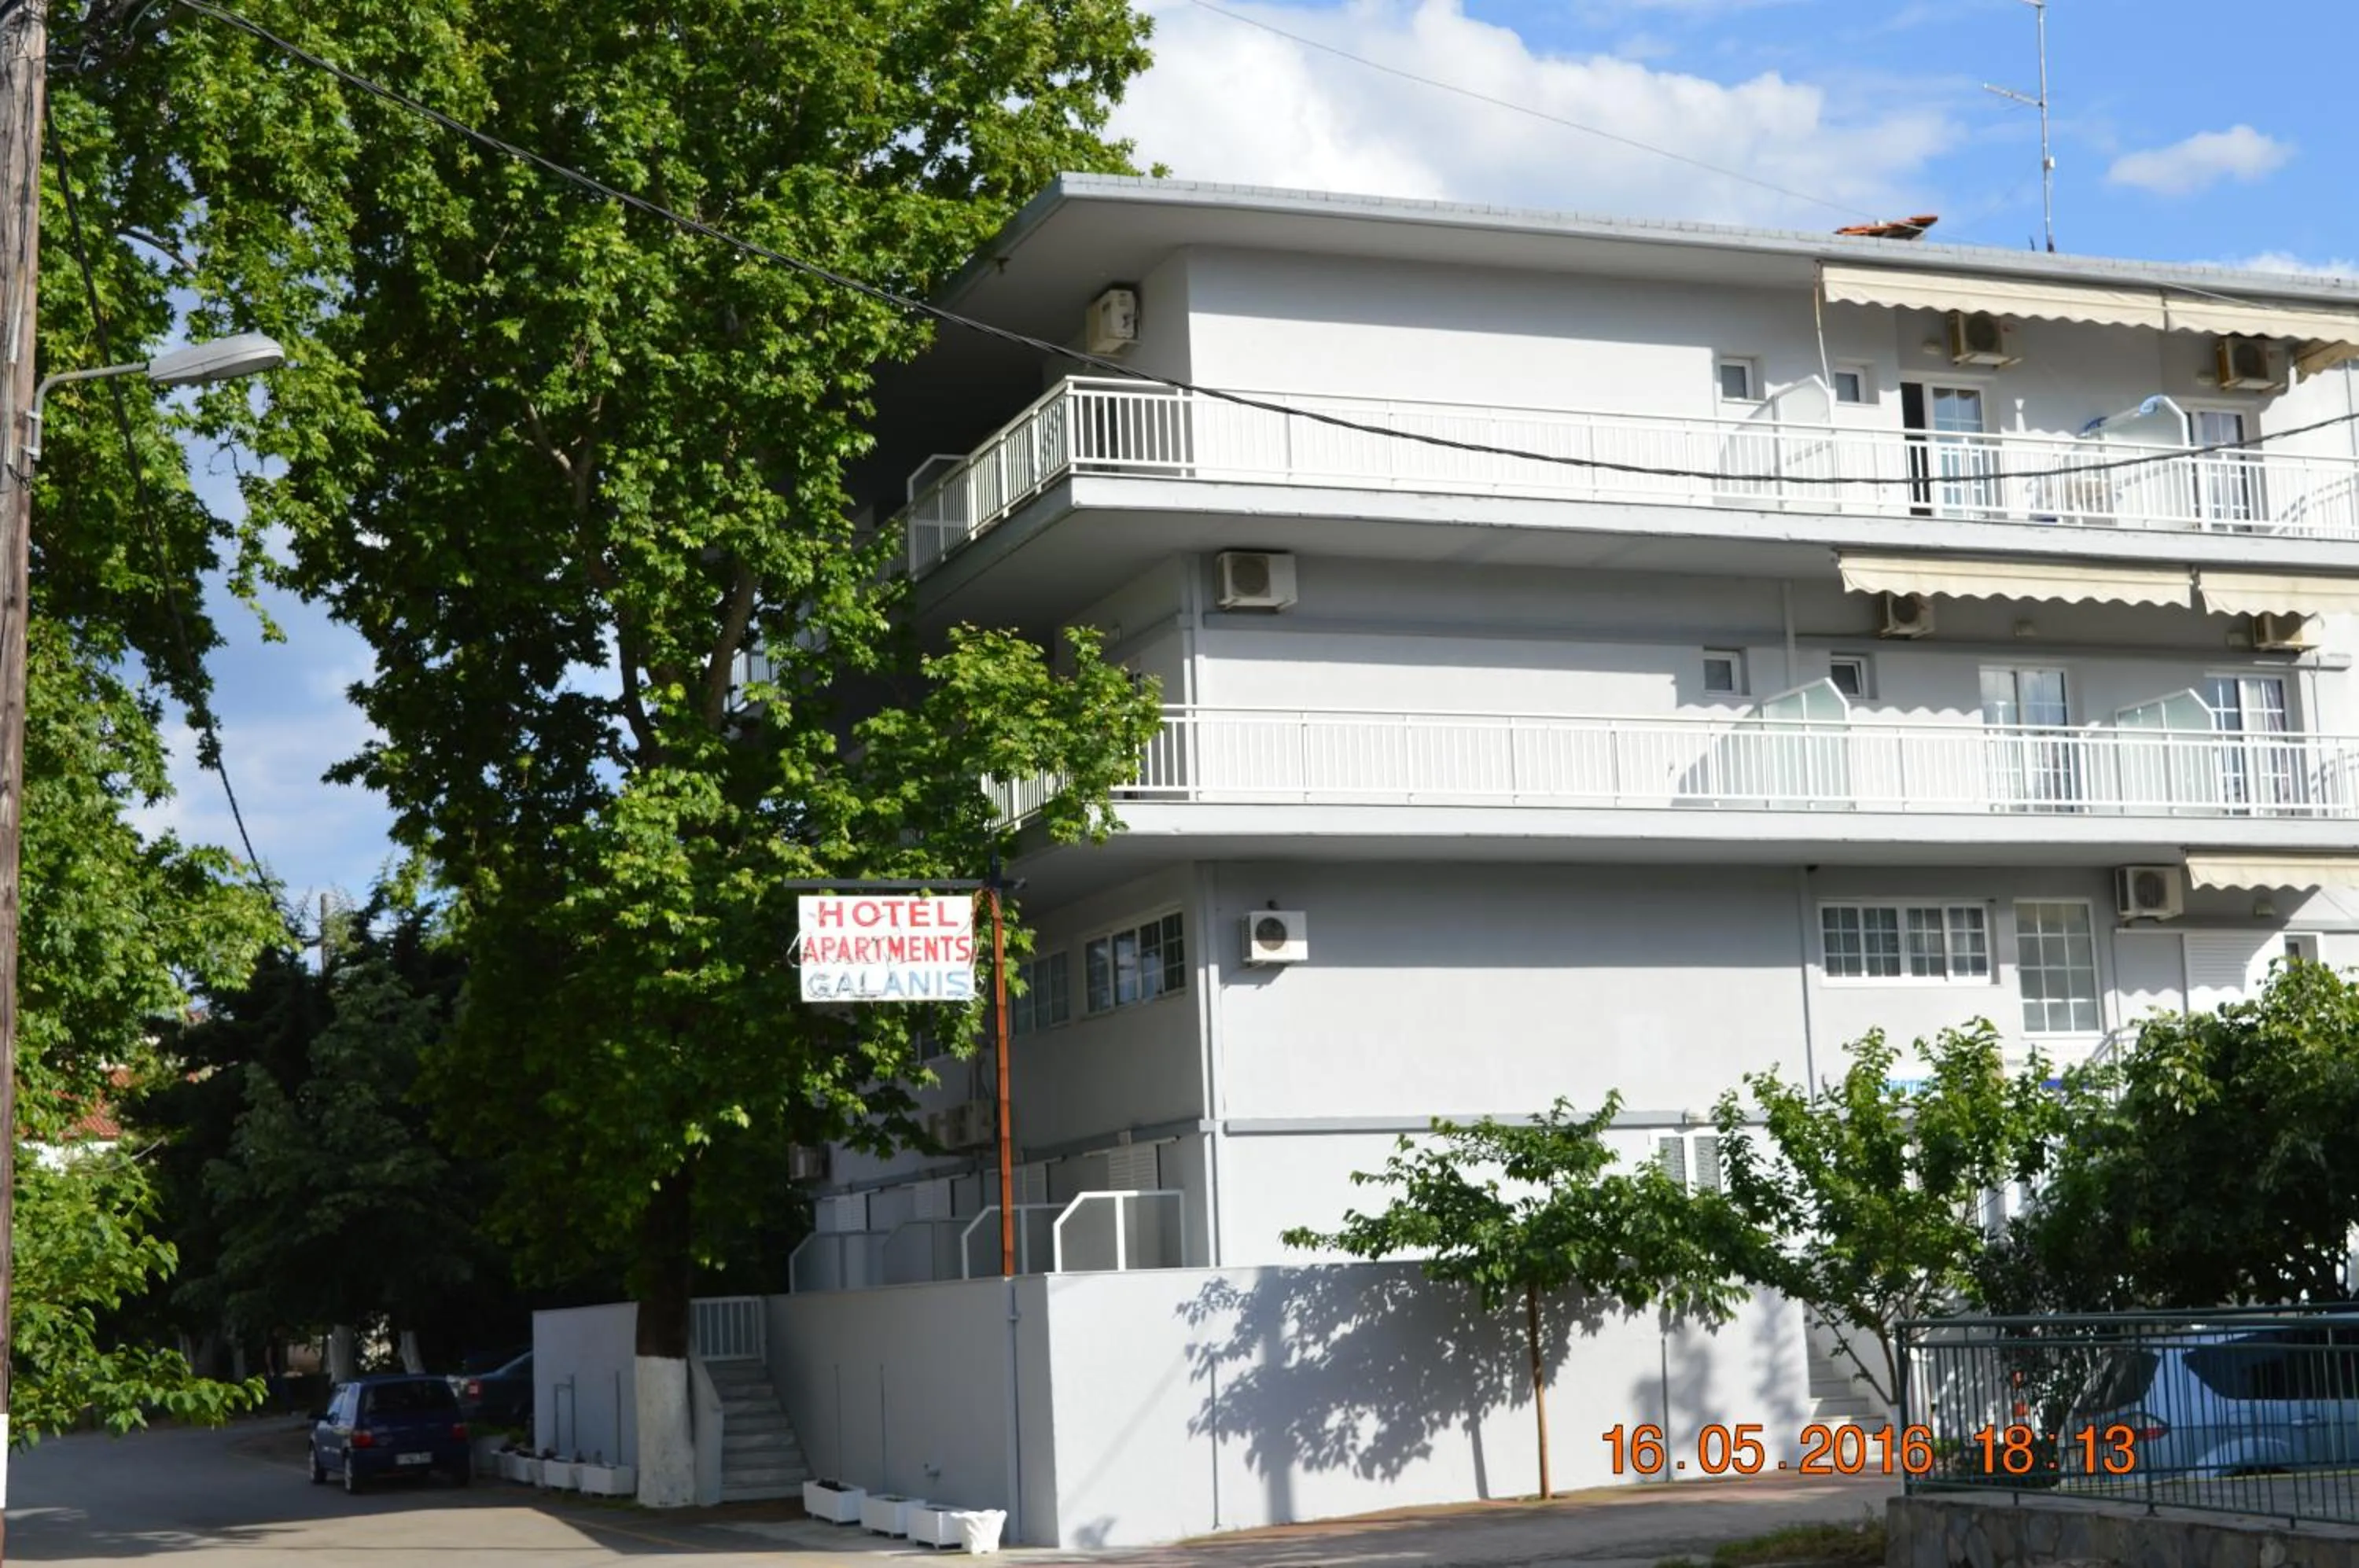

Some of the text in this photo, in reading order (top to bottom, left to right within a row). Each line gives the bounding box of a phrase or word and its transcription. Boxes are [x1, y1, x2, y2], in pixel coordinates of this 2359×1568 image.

[819, 901, 959, 927] HOTEL
[802, 936, 970, 963] APARTMENTS
[806, 970, 970, 998] GALANIS
